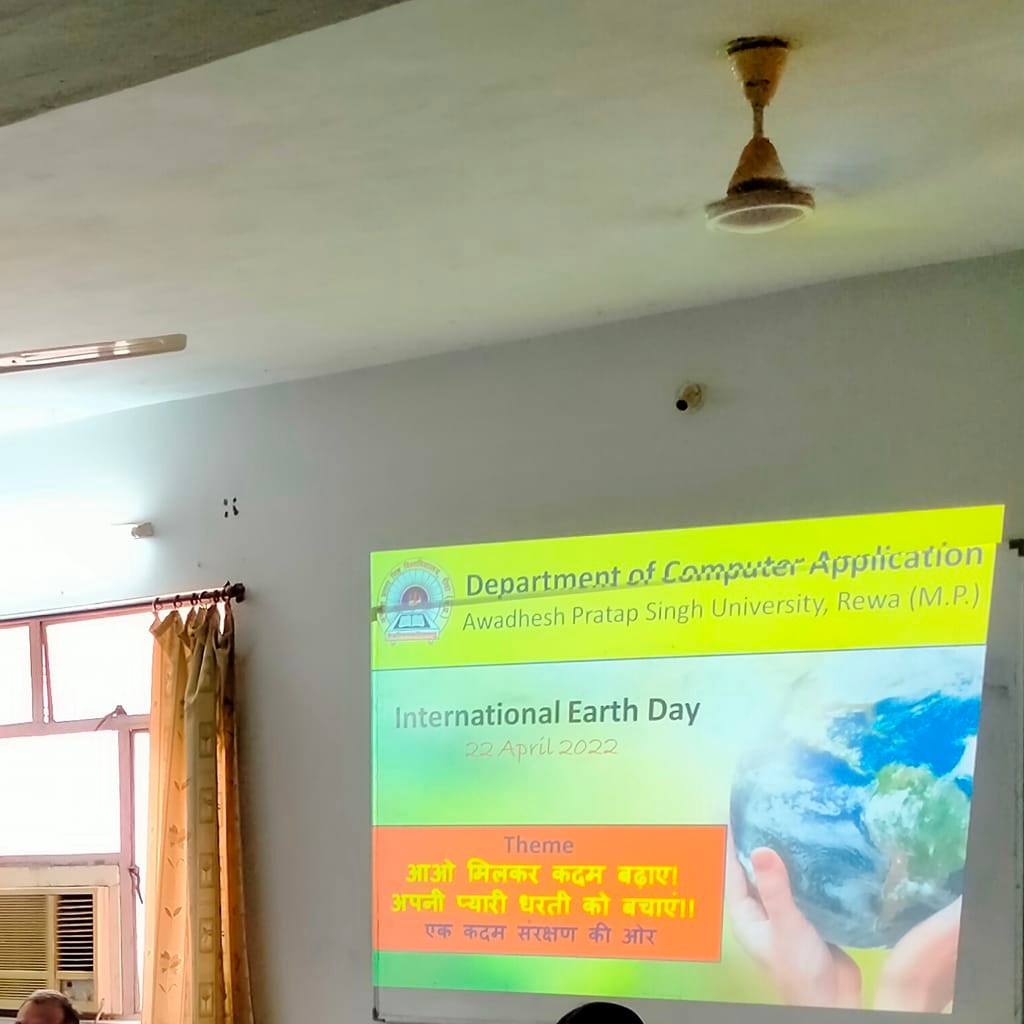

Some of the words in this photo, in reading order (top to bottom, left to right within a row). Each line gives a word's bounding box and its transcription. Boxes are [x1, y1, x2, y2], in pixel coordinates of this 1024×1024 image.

[466, 566, 621, 599] Department
[627, 560, 657, 585] of
[662, 556, 805, 586] Computer
[809, 541, 984, 579] Application
[462, 608, 566, 631] Awadhesh
[572, 607, 639, 626] Pratap
[645, 599, 704, 624] Singh
[711, 595, 829, 617] University,
[837, 590, 901, 611] Rewa
[909, 583, 981, 612] (M.P.)
[395, 700, 561, 729] International
[568, 697, 639, 724] Earth
[648, 697, 702, 726] Day
[465, 742, 494, 758] 22
[496, 737, 553, 764] April
[559, 738, 619, 757] 2022
[504, 835, 574, 854] Theme
[405, 858, 456, 883] आओ
[466, 857, 542, 885] मिलकर
[551, 865, 607, 887] कदम
[391, 888, 446, 912] अपनी
[456, 888, 508, 915] प्यारी
[519, 890, 572, 916] धरती
[582, 891, 611, 916] को
[425, 923, 453, 938] एक
[463, 924, 507, 941] कदम
[588, 921, 612, 944] की
[622, 925, 657, 945] ओर
